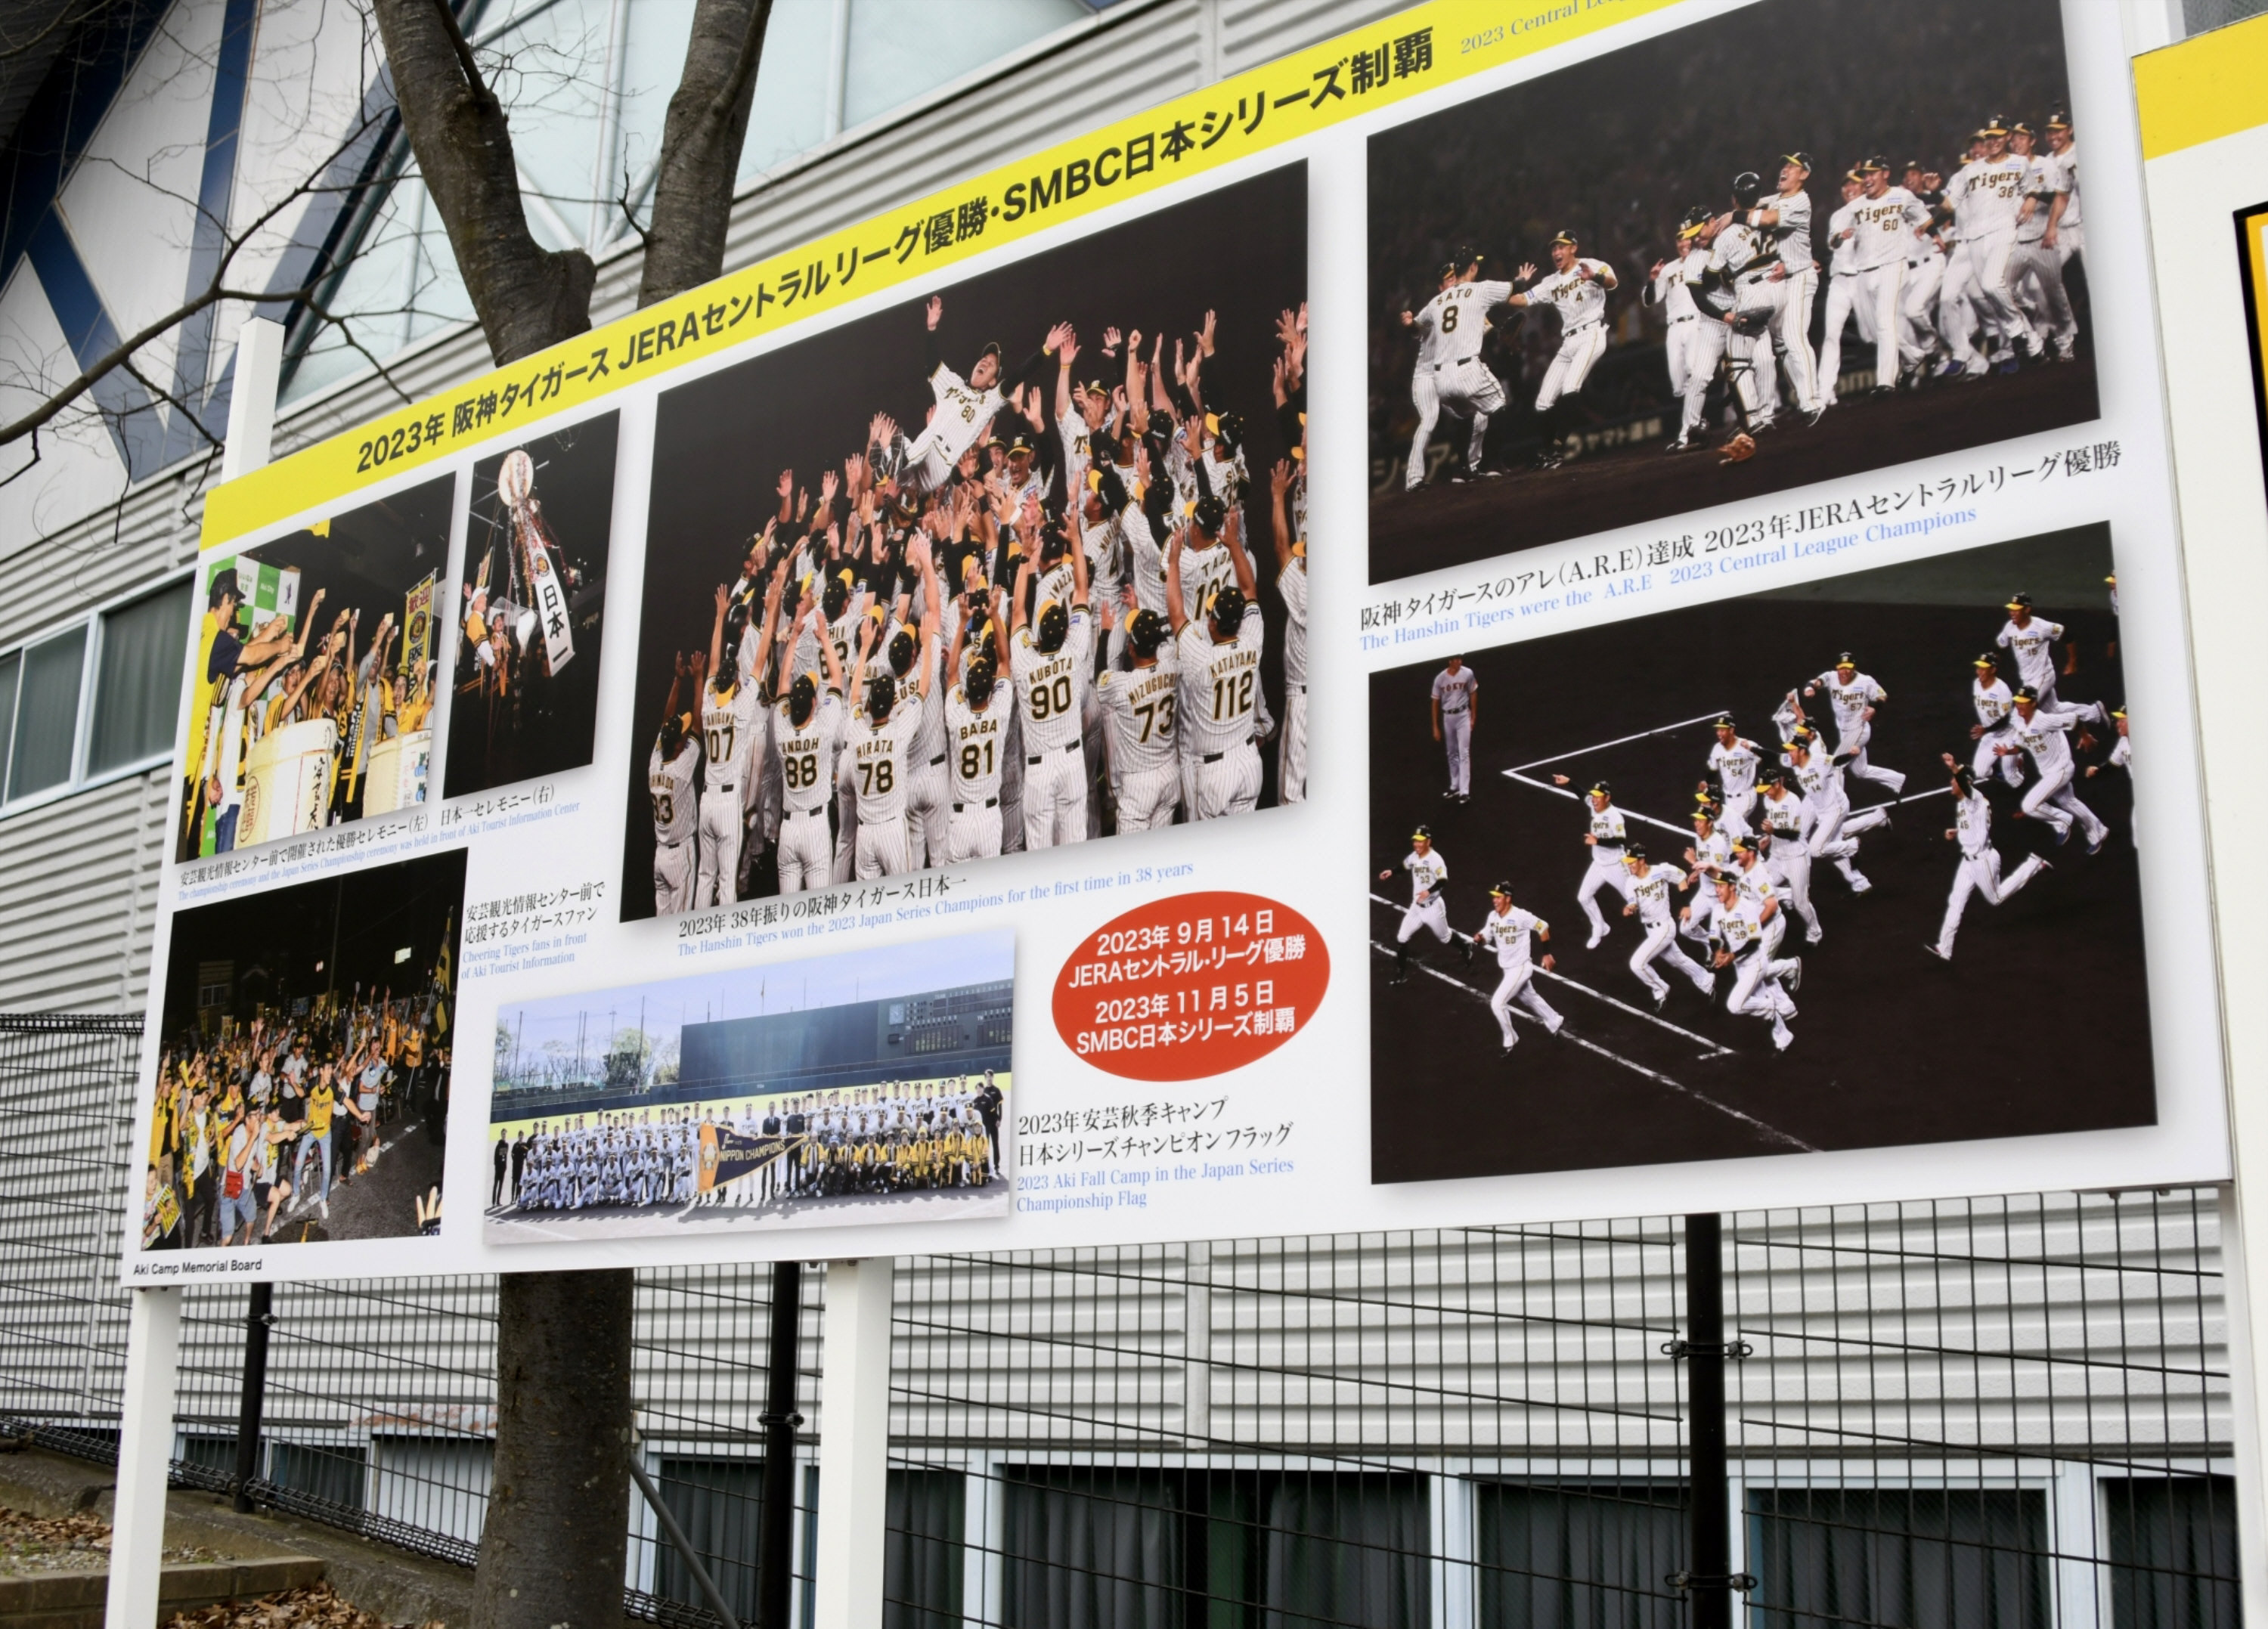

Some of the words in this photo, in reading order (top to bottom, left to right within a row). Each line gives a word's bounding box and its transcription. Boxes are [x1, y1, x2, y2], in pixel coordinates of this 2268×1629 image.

[1461, 26, 1504, 54] 2023
[1510, 0, 1579, 35] Central
[1854, 203, 1904, 225] Tigers
[1436, 287, 1473, 306] SATO
[1441, 305, 1458, 334] 8
[356, 413, 445, 474] 2023年
[451, 347, 610, 438] 阪神タイガース
[961, 405, 976, 423] 80
[1359, 634, 1390, 651] The
[1394, 618, 1460, 644] Hanshin
[1464, 607, 1515, 629] Tigers
[1520, 598, 1560, 617] were
[1565, 590, 1592, 607] the
[1669, 561, 1713, 584] 2023
[1720, 545, 1787, 573] Central
[1792, 532, 1859, 559] League
[1865, 506, 1977, 542] Champions
[543, 584, 569, 663] 日本一
[1029, 657, 1073, 684] KUBOTA
[1210, 650, 1257, 679] KATAYAMA
[1030, 675, 1071, 720] 90
[1213, 669, 1253, 720] 112
[959, 719, 997, 741] BABA
[1134, 693, 1176, 743] 73
[782, 737, 820, 756] ANDOH
[856, 740, 894, 757] HIRATA
[961, 739, 994, 780] 81
[785, 754, 818, 789] 88
[857, 760, 894, 796] 78
[178, 890, 189, 901] The
[258, 872, 270, 882] and
[270, 869, 280, 879] the
[281, 866, 299, 881] Japan
[300, 860, 318, 873] Series
[320, 850, 365, 868] Championship
[366, 843, 398, 857] ceremony
[400, 841, 412, 850] was
[414, 835, 429, 848] held
[430, 833, 438, 843] in
[440, 828, 457, 841] front
[458, 825, 466, 837] of
[467, 822, 479, 835] Aki
[482, 817, 507, 832] Tourist
[509, 809, 552, 825] Information
[554, 802, 581, 816] Center
[464, 907, 599, 944] 応援するタイガースファン
[677, 943, 697, 956] The
[699, 936, 742, 953] Hanshin
[745, 931, 778, 946] Tigers
[781, 928, 804, 939] won
[807, 922, 824, 935] the
[828, 916, 855, 933] 2023
[858, 912, 892, 928] Japan
[896, 905, 931, 921] Series
[934, 895, 1004, 915] Champions
[1008, 889, 1026, 903] for
[1030, 885, 1051, 900] the
[1054, 881, 1080, 896] first
[1083, 875, 1114, 890] time
[1117, 871, 1131, 885] in
[1136, 867, 1153, 883] 38
[1157, 863, 1194, 883] years
[679, 913, 727, 938] 2023年
[463, 948, 500, 963] Cheering
[503, 943, 530, 958] Tigers
[532, 939, 550, 951] fans
[553, 936, 562, 947] in
[565, 932, 587, 946] front
[461, 968, 470, 980] of
[472, 965, 487, 978] Aki
[489, 960, 519, 975] Tourist
[522, 952, 575, 970] Information
[1076, 1006, 1296, 1055] SMBC日本シリーズ制覇
[720, 1149, 744, 1162] NIPPON
[745, 1139, 785, 1160] CHAMPIONS
[1017, 1173, 1049, 1191] 2023
[1053, 1172, 1076, 1188] Aki
[1080, 1170, 1105, 1187] Fall
[1111, 1169, 1151, 1186] Camp
[1155, 1166, 1169, 1181] in
[1174, 1164, 1196, 1180] the
[1201, 1162, 1244, 1181] Japan
[1249, 1157, 1294, 1175] Series
[1017, 1193, 1114, 1213] Championship
[1118, 1190, 1148, 1209] Flag
[133, 1263, 149, 1275] Aki
[151, 1263, 180, 1276] Camp
[182, 1260, 228, 1274] Memorial
[231, 1259, 263, 1271] Board
